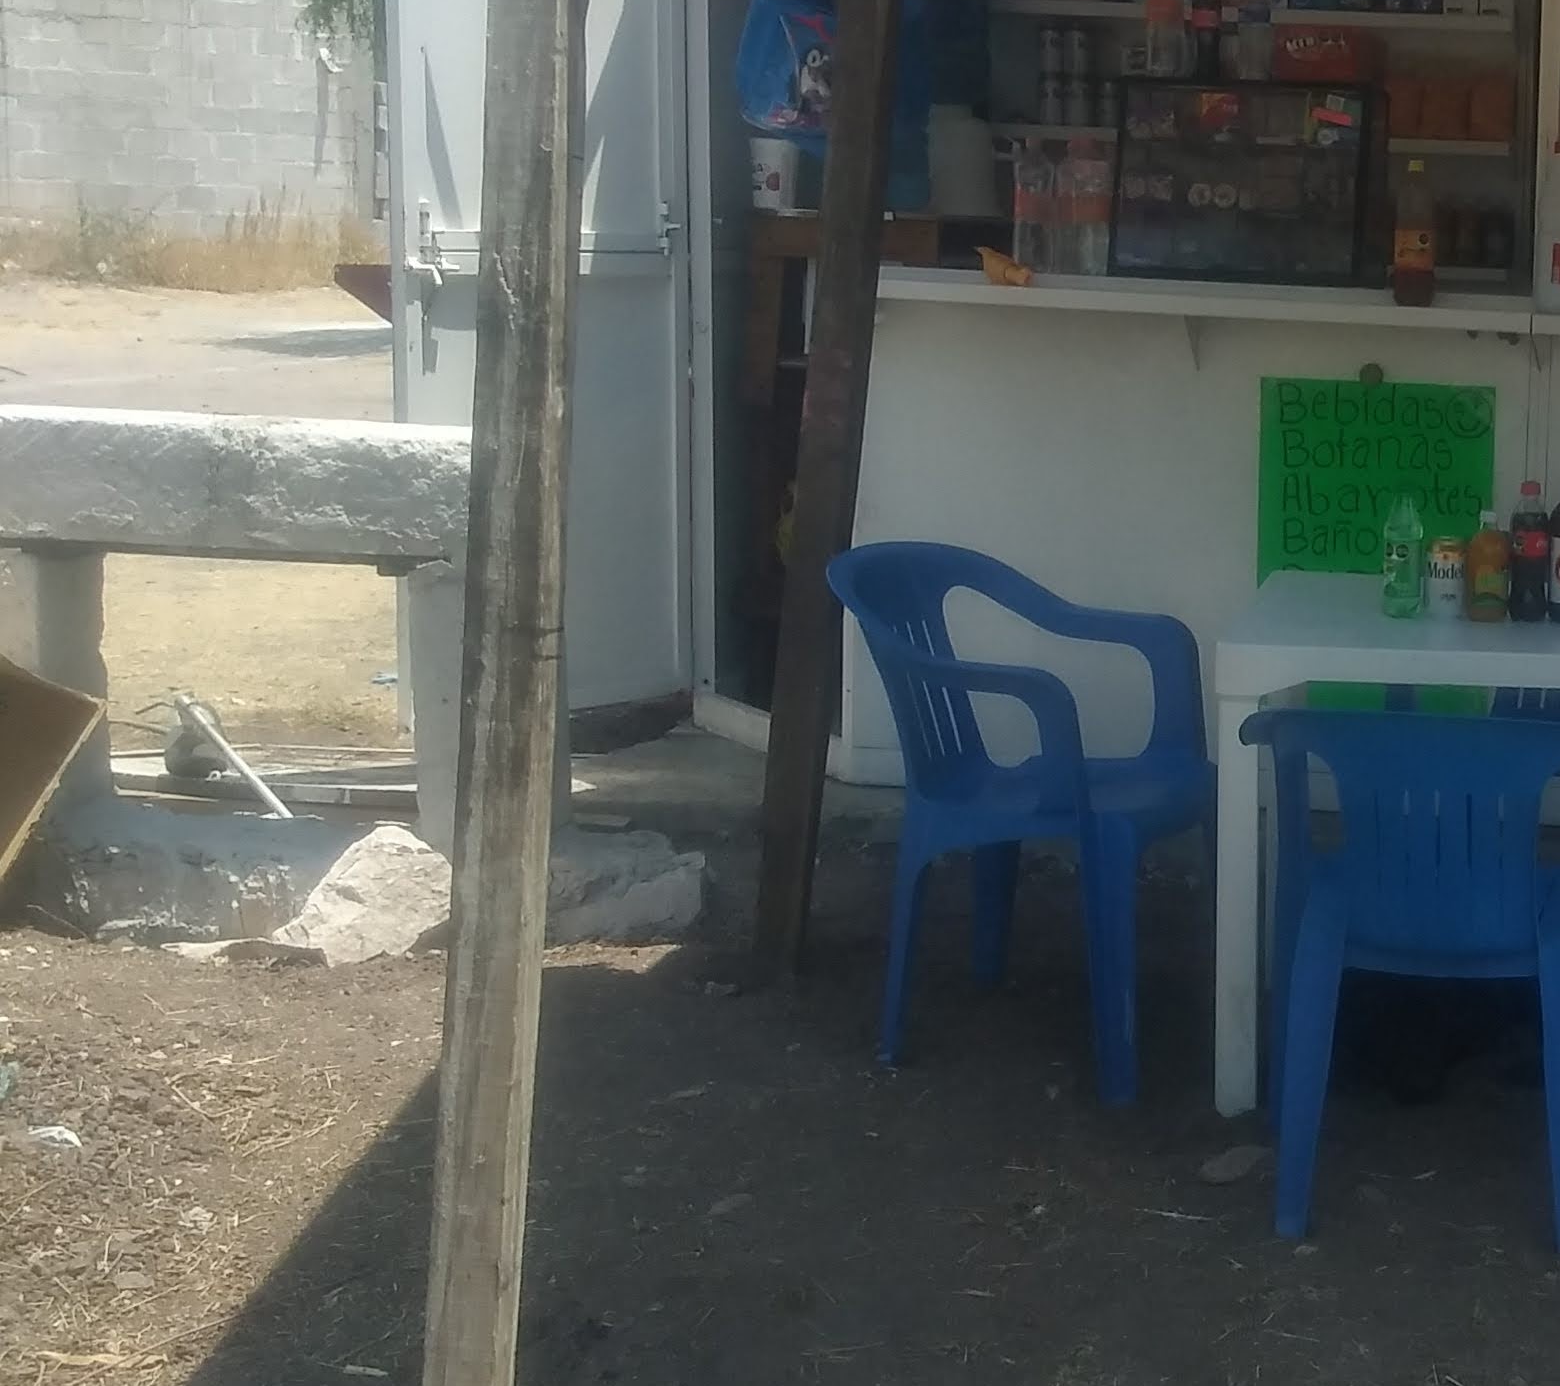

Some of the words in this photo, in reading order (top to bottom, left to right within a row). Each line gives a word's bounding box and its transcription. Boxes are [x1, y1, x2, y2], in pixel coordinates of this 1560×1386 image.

[1277, 381, 1443, 430] Bebidas
[1281, 427, 1453, 471] Botanas
[1282, 473, 1482, 517] Abarotes
[1282, 516, 1378, 558] Baño
